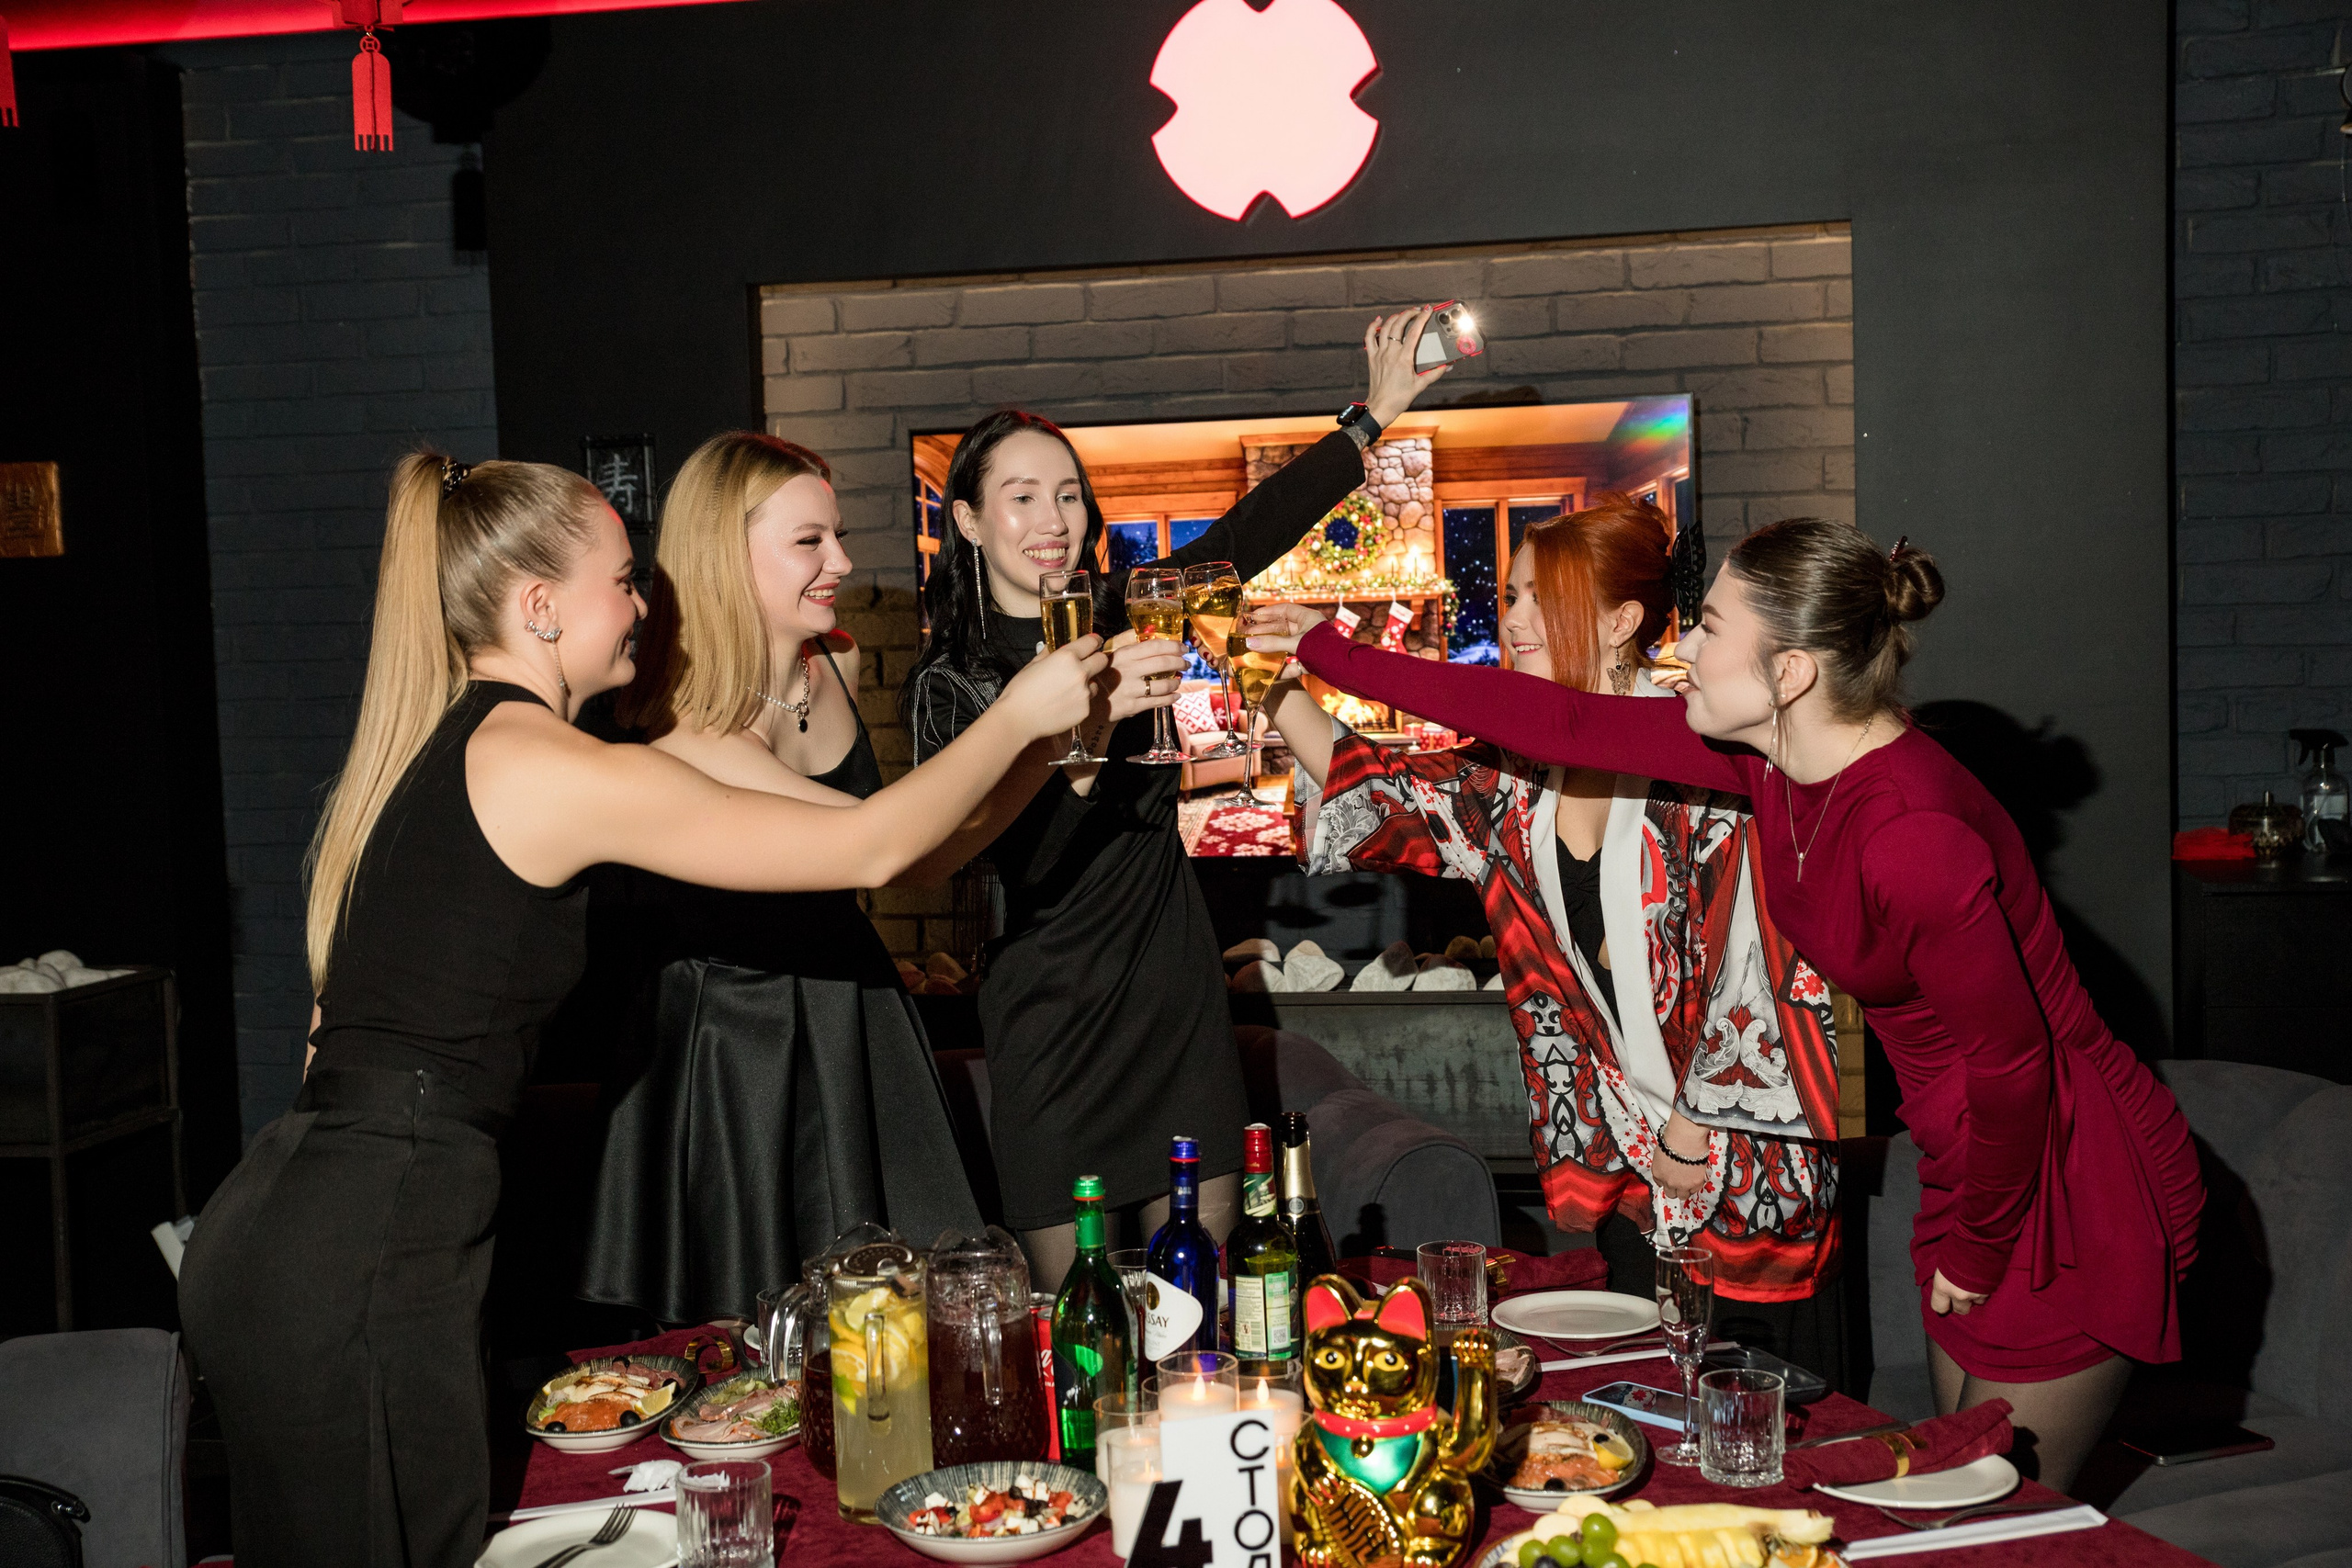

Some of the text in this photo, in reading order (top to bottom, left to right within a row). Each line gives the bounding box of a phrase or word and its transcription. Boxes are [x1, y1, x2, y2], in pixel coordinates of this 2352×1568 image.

[597, 454, 639, 513] 寿
[1146, 1313, 1169, 1327] SSAY
[1125, 1480, 1213, 1568] 4
